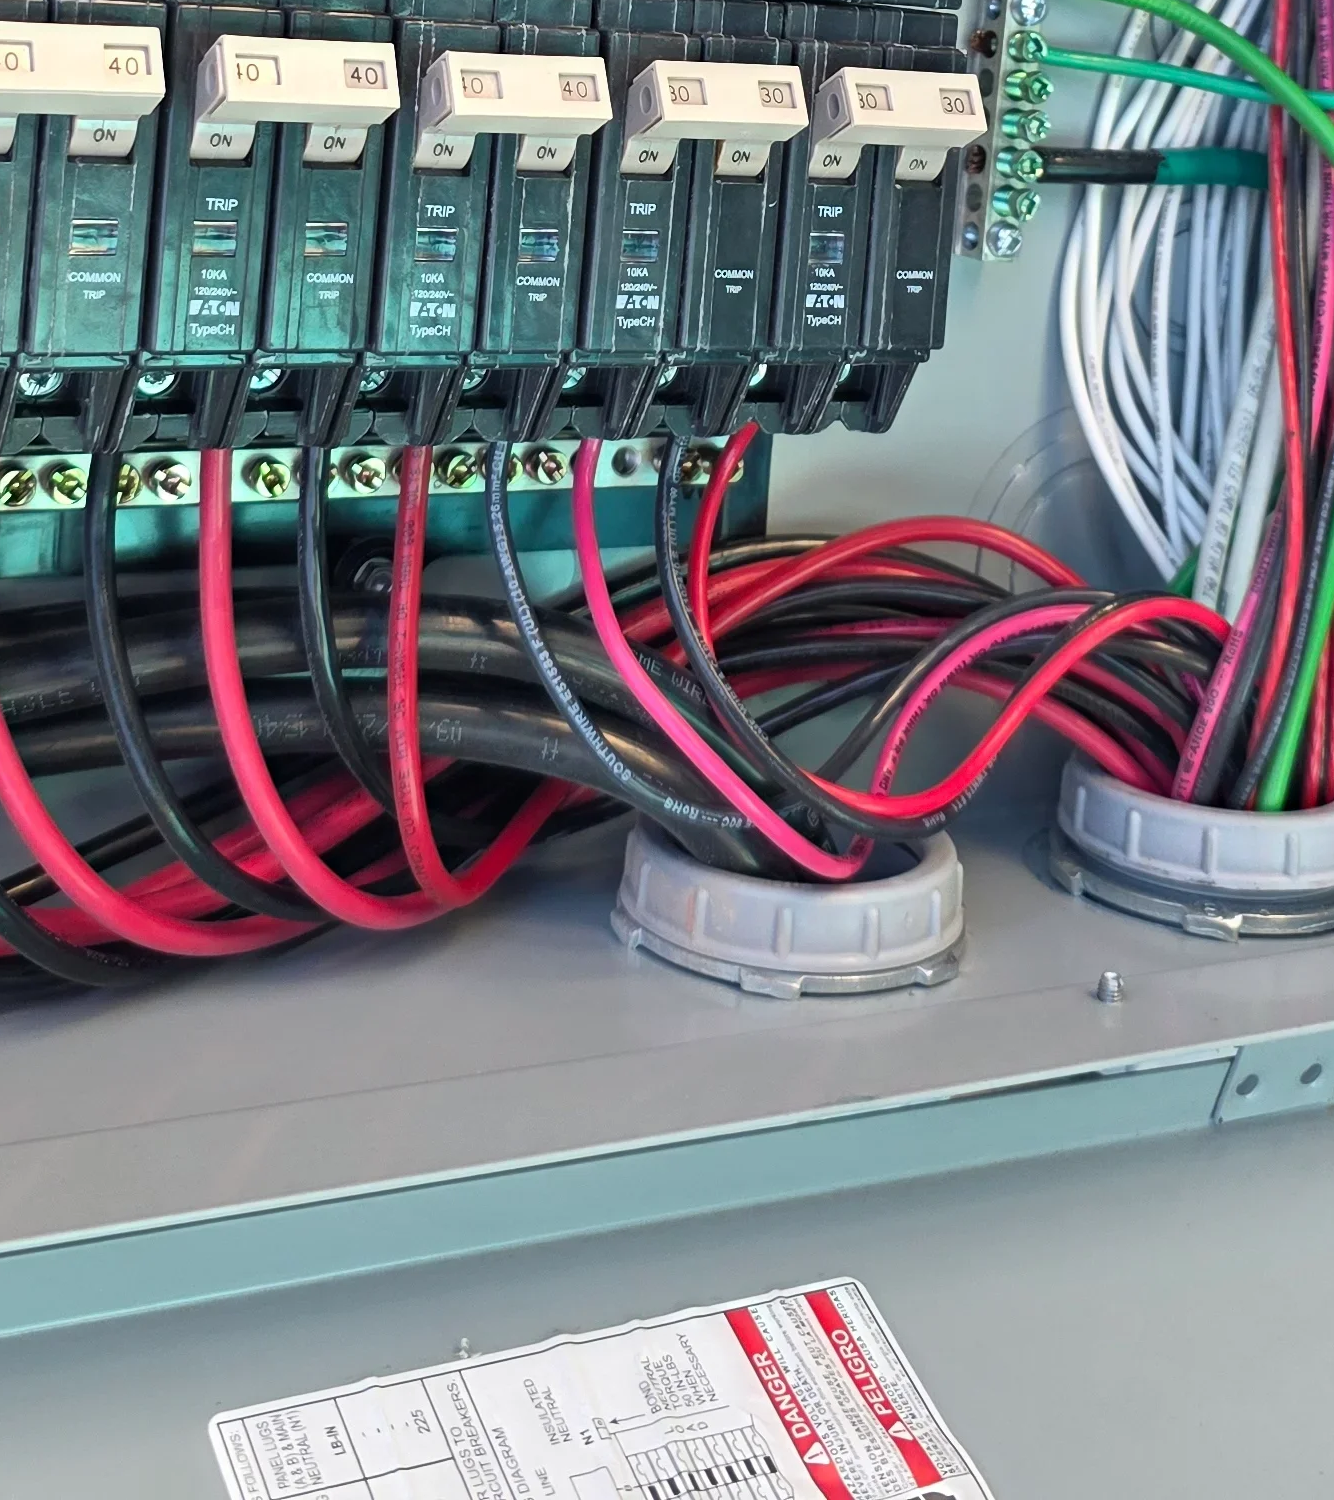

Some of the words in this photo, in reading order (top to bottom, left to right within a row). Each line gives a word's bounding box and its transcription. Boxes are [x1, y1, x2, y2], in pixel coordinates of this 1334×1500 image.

[108, 57, 139, 75] 40
[350, 67, 379, 85] 40
[562, 81, 589, 98] 40
[761, 87, 785, 104] 30
[943, 96, 966, 113] 30
[432, 144, 455, 157] ON
[822, 154, 842, 167] ON
[629, 203, 657, 215] TRIP
[897, 270, 933, 280] COMMON
[1222, 627, 1244, 664] RoHS
[568, 709, 632, 783] SOUTHWIRE
[663, 796, 700, 820] RoHS
[750, 1306, 773, 1342] CAUSE
[828, 1288, 857, 1332] HERIDAS
[675, 1332, 718, 1402] NECESSARY
[772, 1347, 790, 1373] WILL
[854, 1335, 879, 1369] CAUSA
[640, 1355, 671, 1409] NEUTRAL
[652, 1359, 683, 1410] TORQUE
[661, 1353, 686, 1391] IN-LBS
[682, 1369, 706, 1405] WHEN
[793, 1364, 817, 1398] DEATH.
[830, 1327, 890, 1416] PELIGRO
[522, 1377, 560, 1445] INSULATED
[637, 1379, 662, 1413] BOND
[681, 1393, 694, 1407] 50
[751, 1349, 812, 1439] DANGER
[813, 1400, 826, 1414] OR
[270, 1413, 290, 1441] MAIN
[285, 1409, 305, 1432] (N1)
[411, 1408, 430, 1434] 225
[445, 1378, 486, 1456] BREAKERS.
[540, 1385, 572, 1442] NEUTRAL
[256, 1419, 277, 1452] LUGS
[324, 1425, 346, 1456] LB-IN
[449, 1425, 466, 1445] TO
[579, 1428, 594, 1445] N1
[823, 1417, 848, 1455] INJURY
[228, 1429, 258, 1493] FOLLOWS:
[266, 1452, 289, 1489] PANEL
[293, 1433, 323, 1486] NEUTRAL
[458, 1447, 484, 1486] LUGS
[491, 1425, 530, 1493] DIAGRAM
[535, 1467, 555, 1496] LINE
